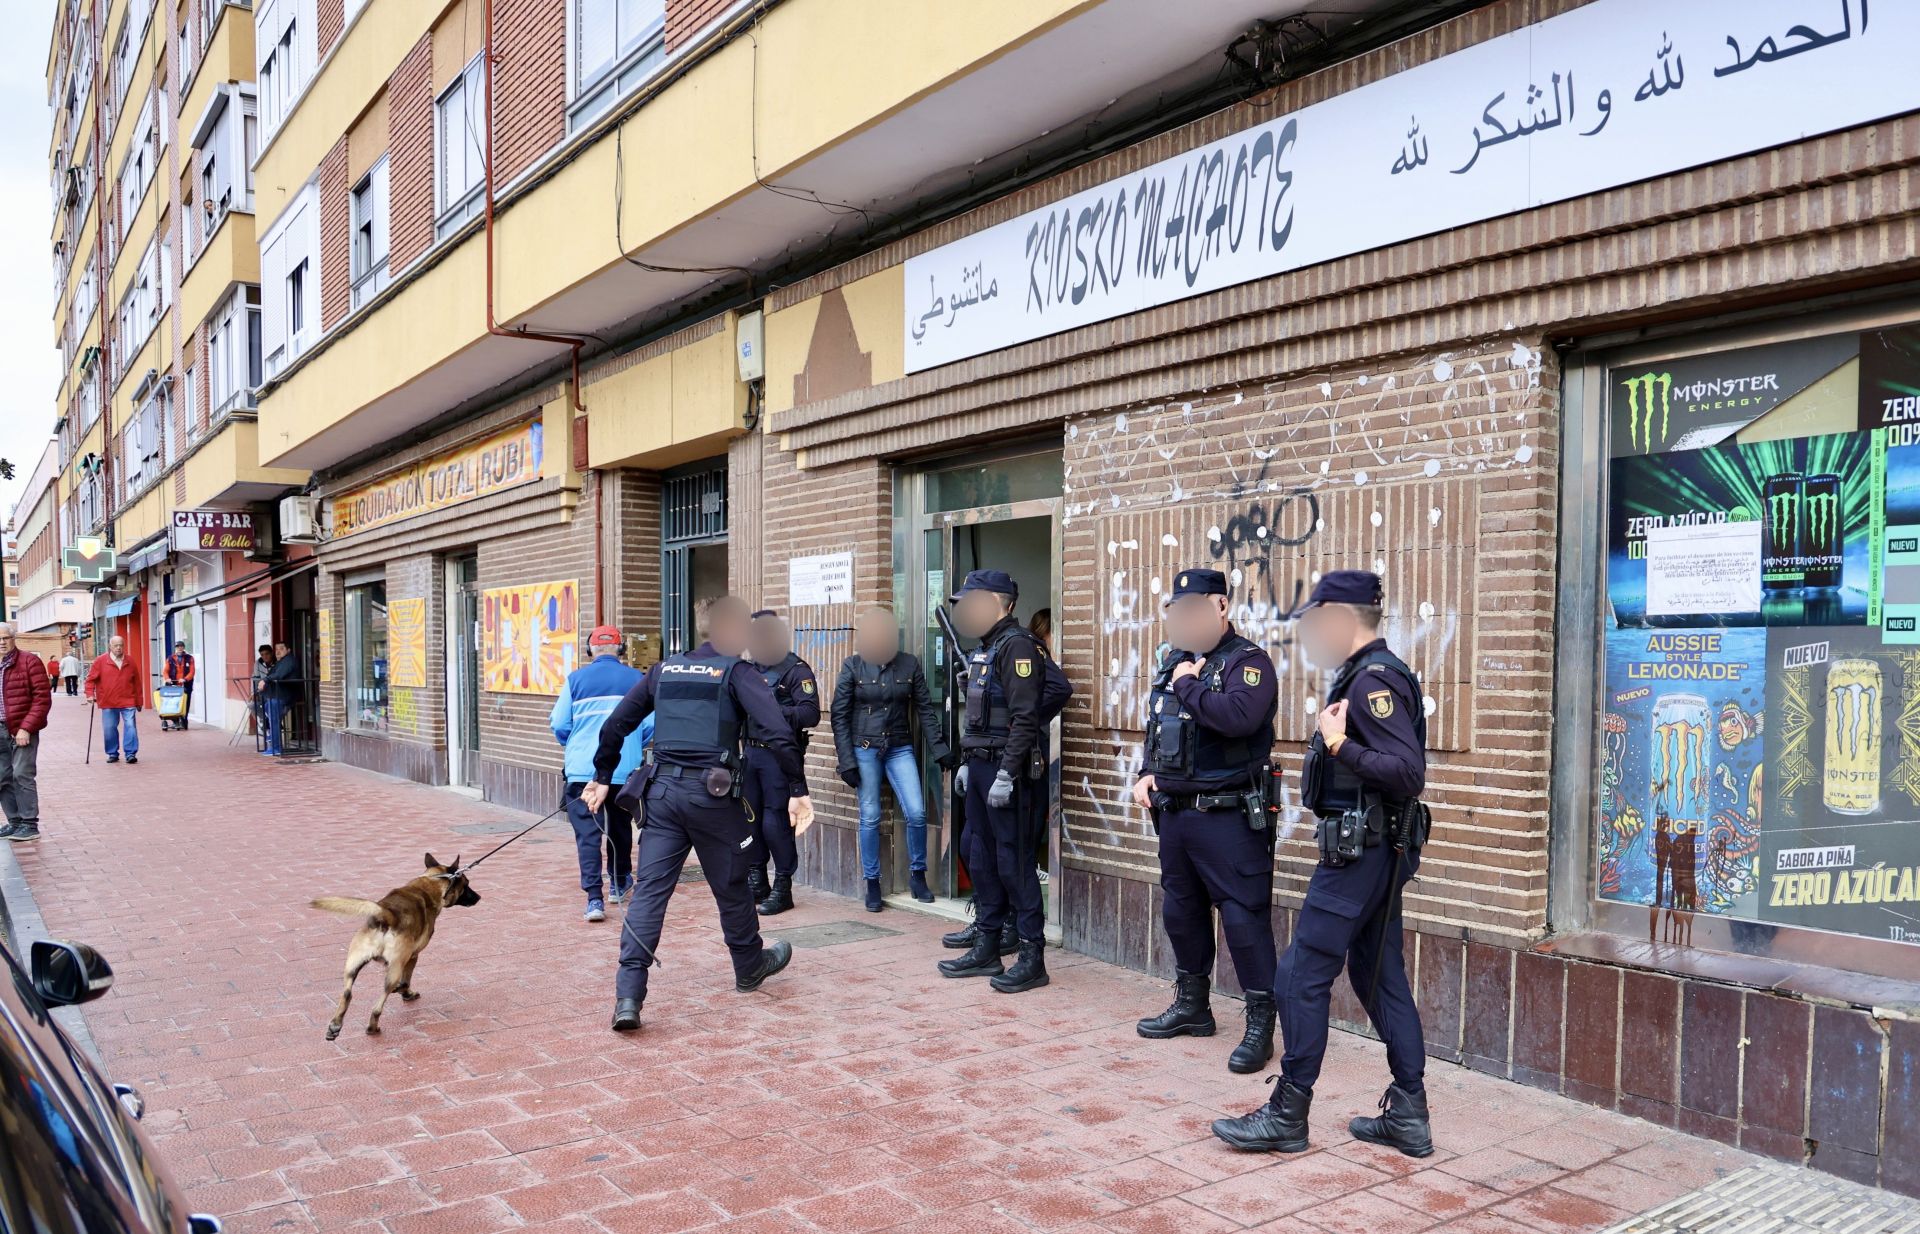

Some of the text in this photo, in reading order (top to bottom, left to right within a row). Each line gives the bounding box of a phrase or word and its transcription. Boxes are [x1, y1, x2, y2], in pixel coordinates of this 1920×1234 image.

[1025, 118, 1298, 315] KIOSKO MACHOTE
[1673, 373, 1780, 402] MONSTER
[1688, 396, 1762, 412] ENERGY
[349, 469, 425, 530] LIQUIDACIÓN
[428, 459, 475, 503] TOTAL
[201, 533, 252, 548] El Rollo
[1890, 540, 1916, 551] NUEVO
[1888, 619, 1913, 630] NUEVO
[1648, 635, 1721, 652] AUSSIE
[1666, 653, 1702, 662] STYLE
[1786, 643, 1827, 666] NUEVO
[1616, 688, 1650, 703] NUEVO
[1778, 847, 1853, 868] SABOR A PIÑA
[1769, 871, 1832, 907] ZERO
